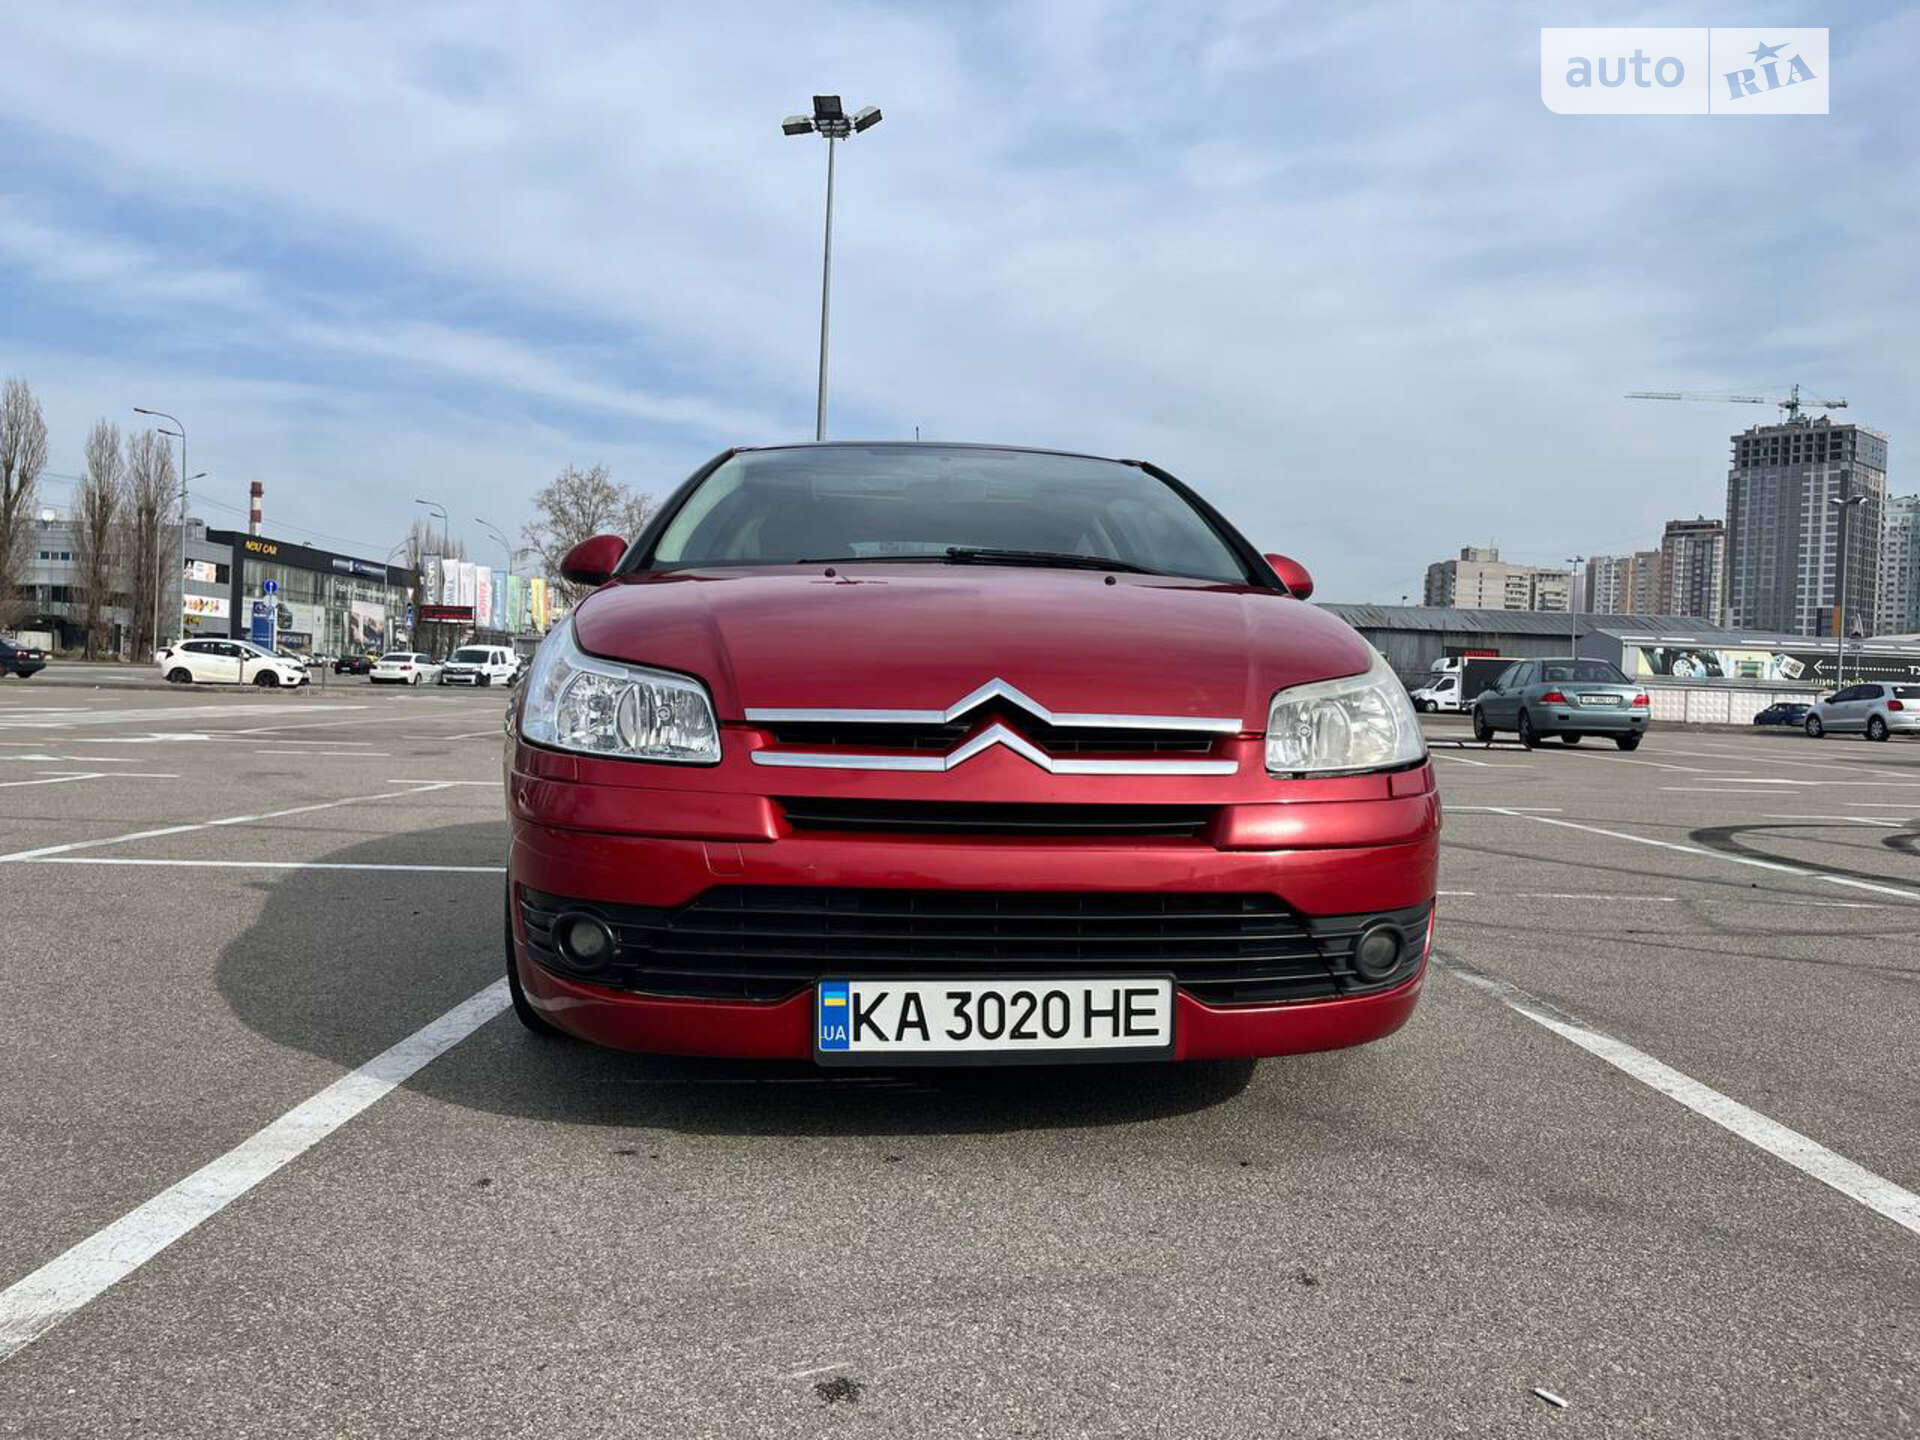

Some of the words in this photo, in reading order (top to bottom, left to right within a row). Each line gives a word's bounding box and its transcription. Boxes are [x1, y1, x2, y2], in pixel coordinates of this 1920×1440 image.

[853, 991, 931, 1042] KA
[945, 989, 1071, 1041] 3020
[1084, 988, 1160, 1038] HE
[824, 1025, 847, 1042] UA
